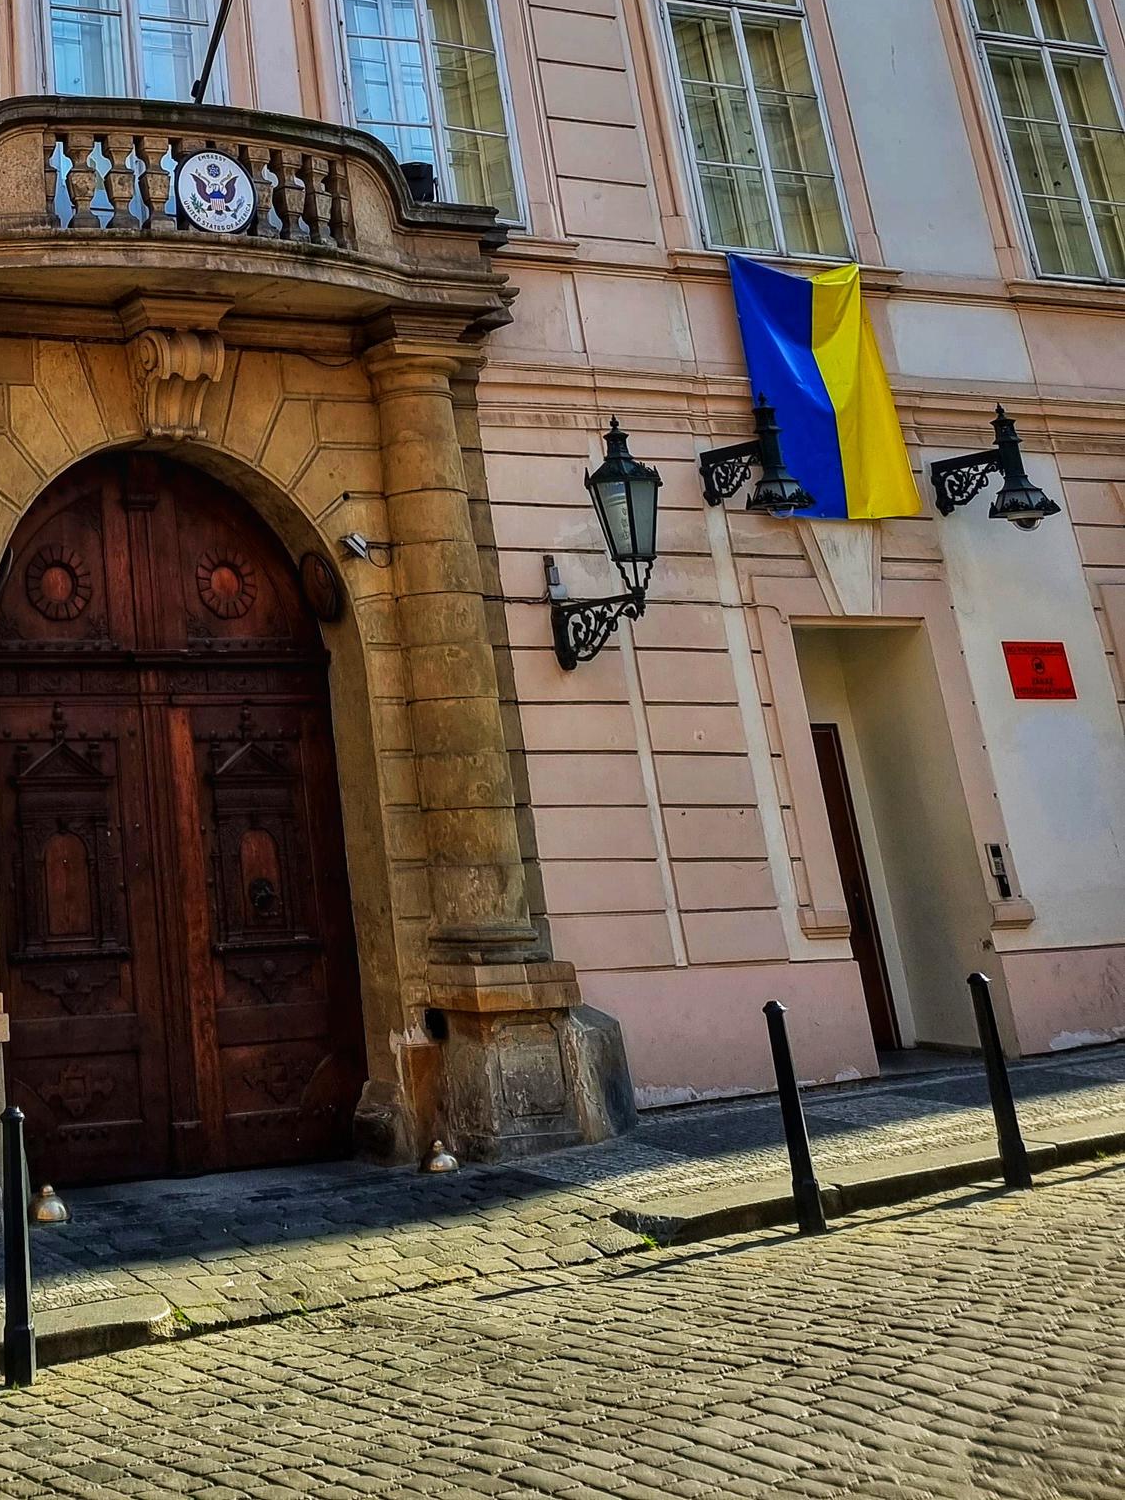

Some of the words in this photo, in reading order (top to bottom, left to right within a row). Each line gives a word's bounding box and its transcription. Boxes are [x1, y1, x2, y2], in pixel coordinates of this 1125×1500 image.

[198, 154, 227, 162] EMBASSY
[183, 200, 201, 222] UNITED
[202, 220, 226, 231] STATES
[235, 203, 252, 227] AMERICA
